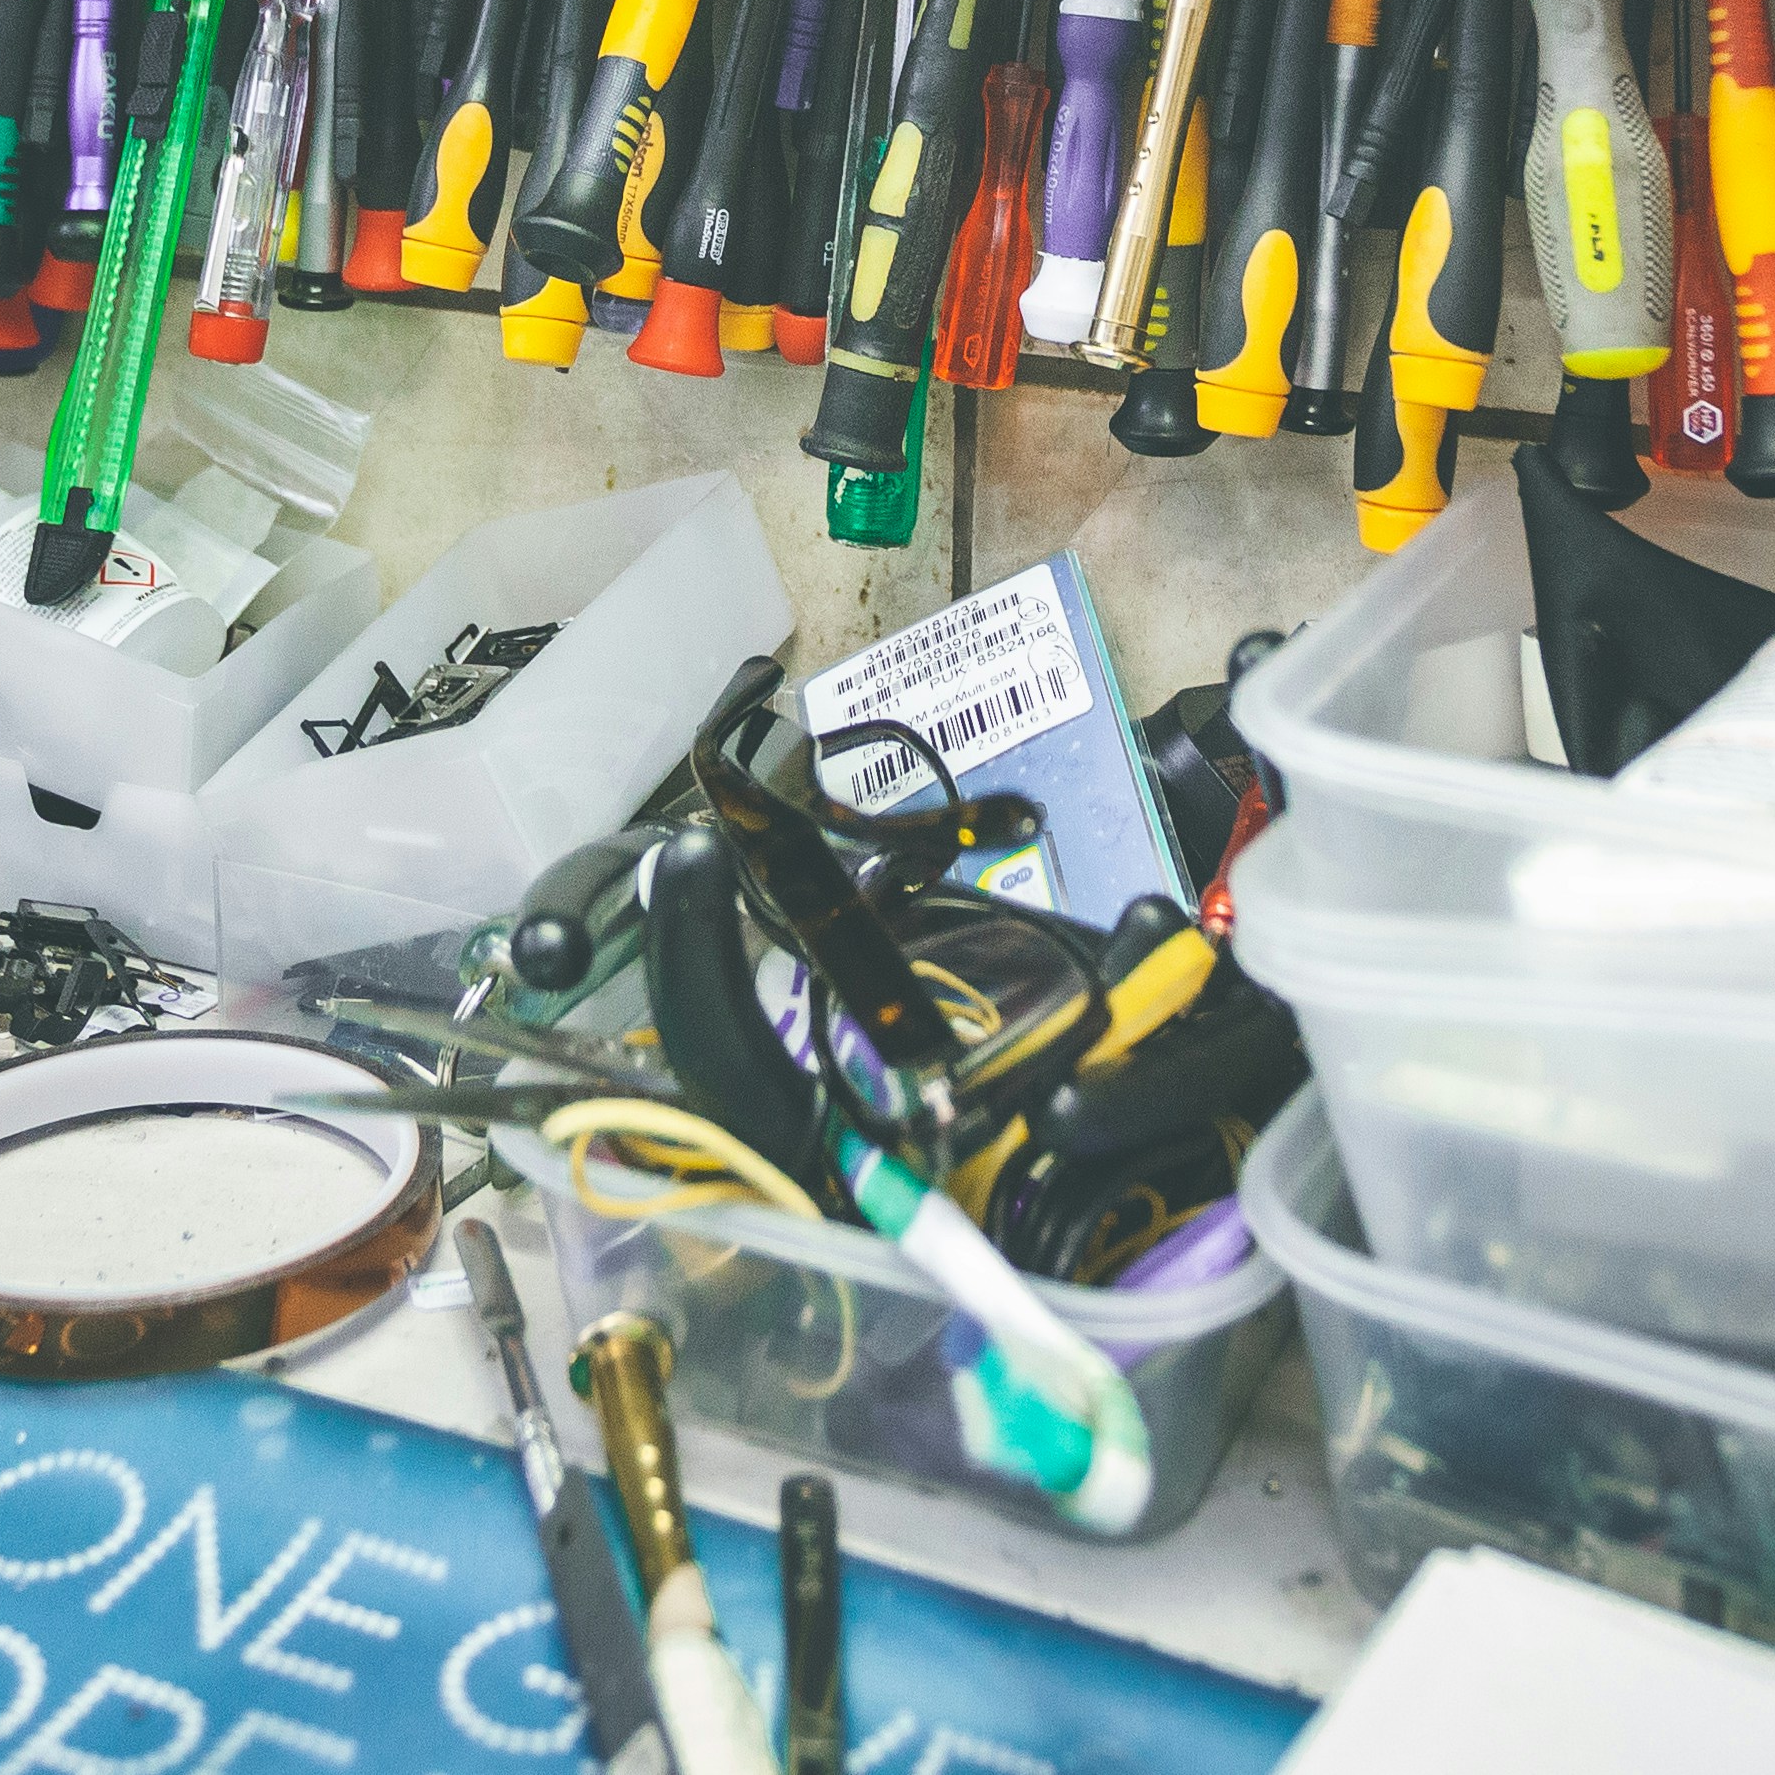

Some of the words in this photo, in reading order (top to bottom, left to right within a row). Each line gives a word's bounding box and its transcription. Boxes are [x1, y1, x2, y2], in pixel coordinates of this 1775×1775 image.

[96, 51, 118, 142] BAKU
[711, 209, 730, 261] DRAPER
[864, 599, 981, 666] 341232181732
[989, 666, 1019, 688] SIM
